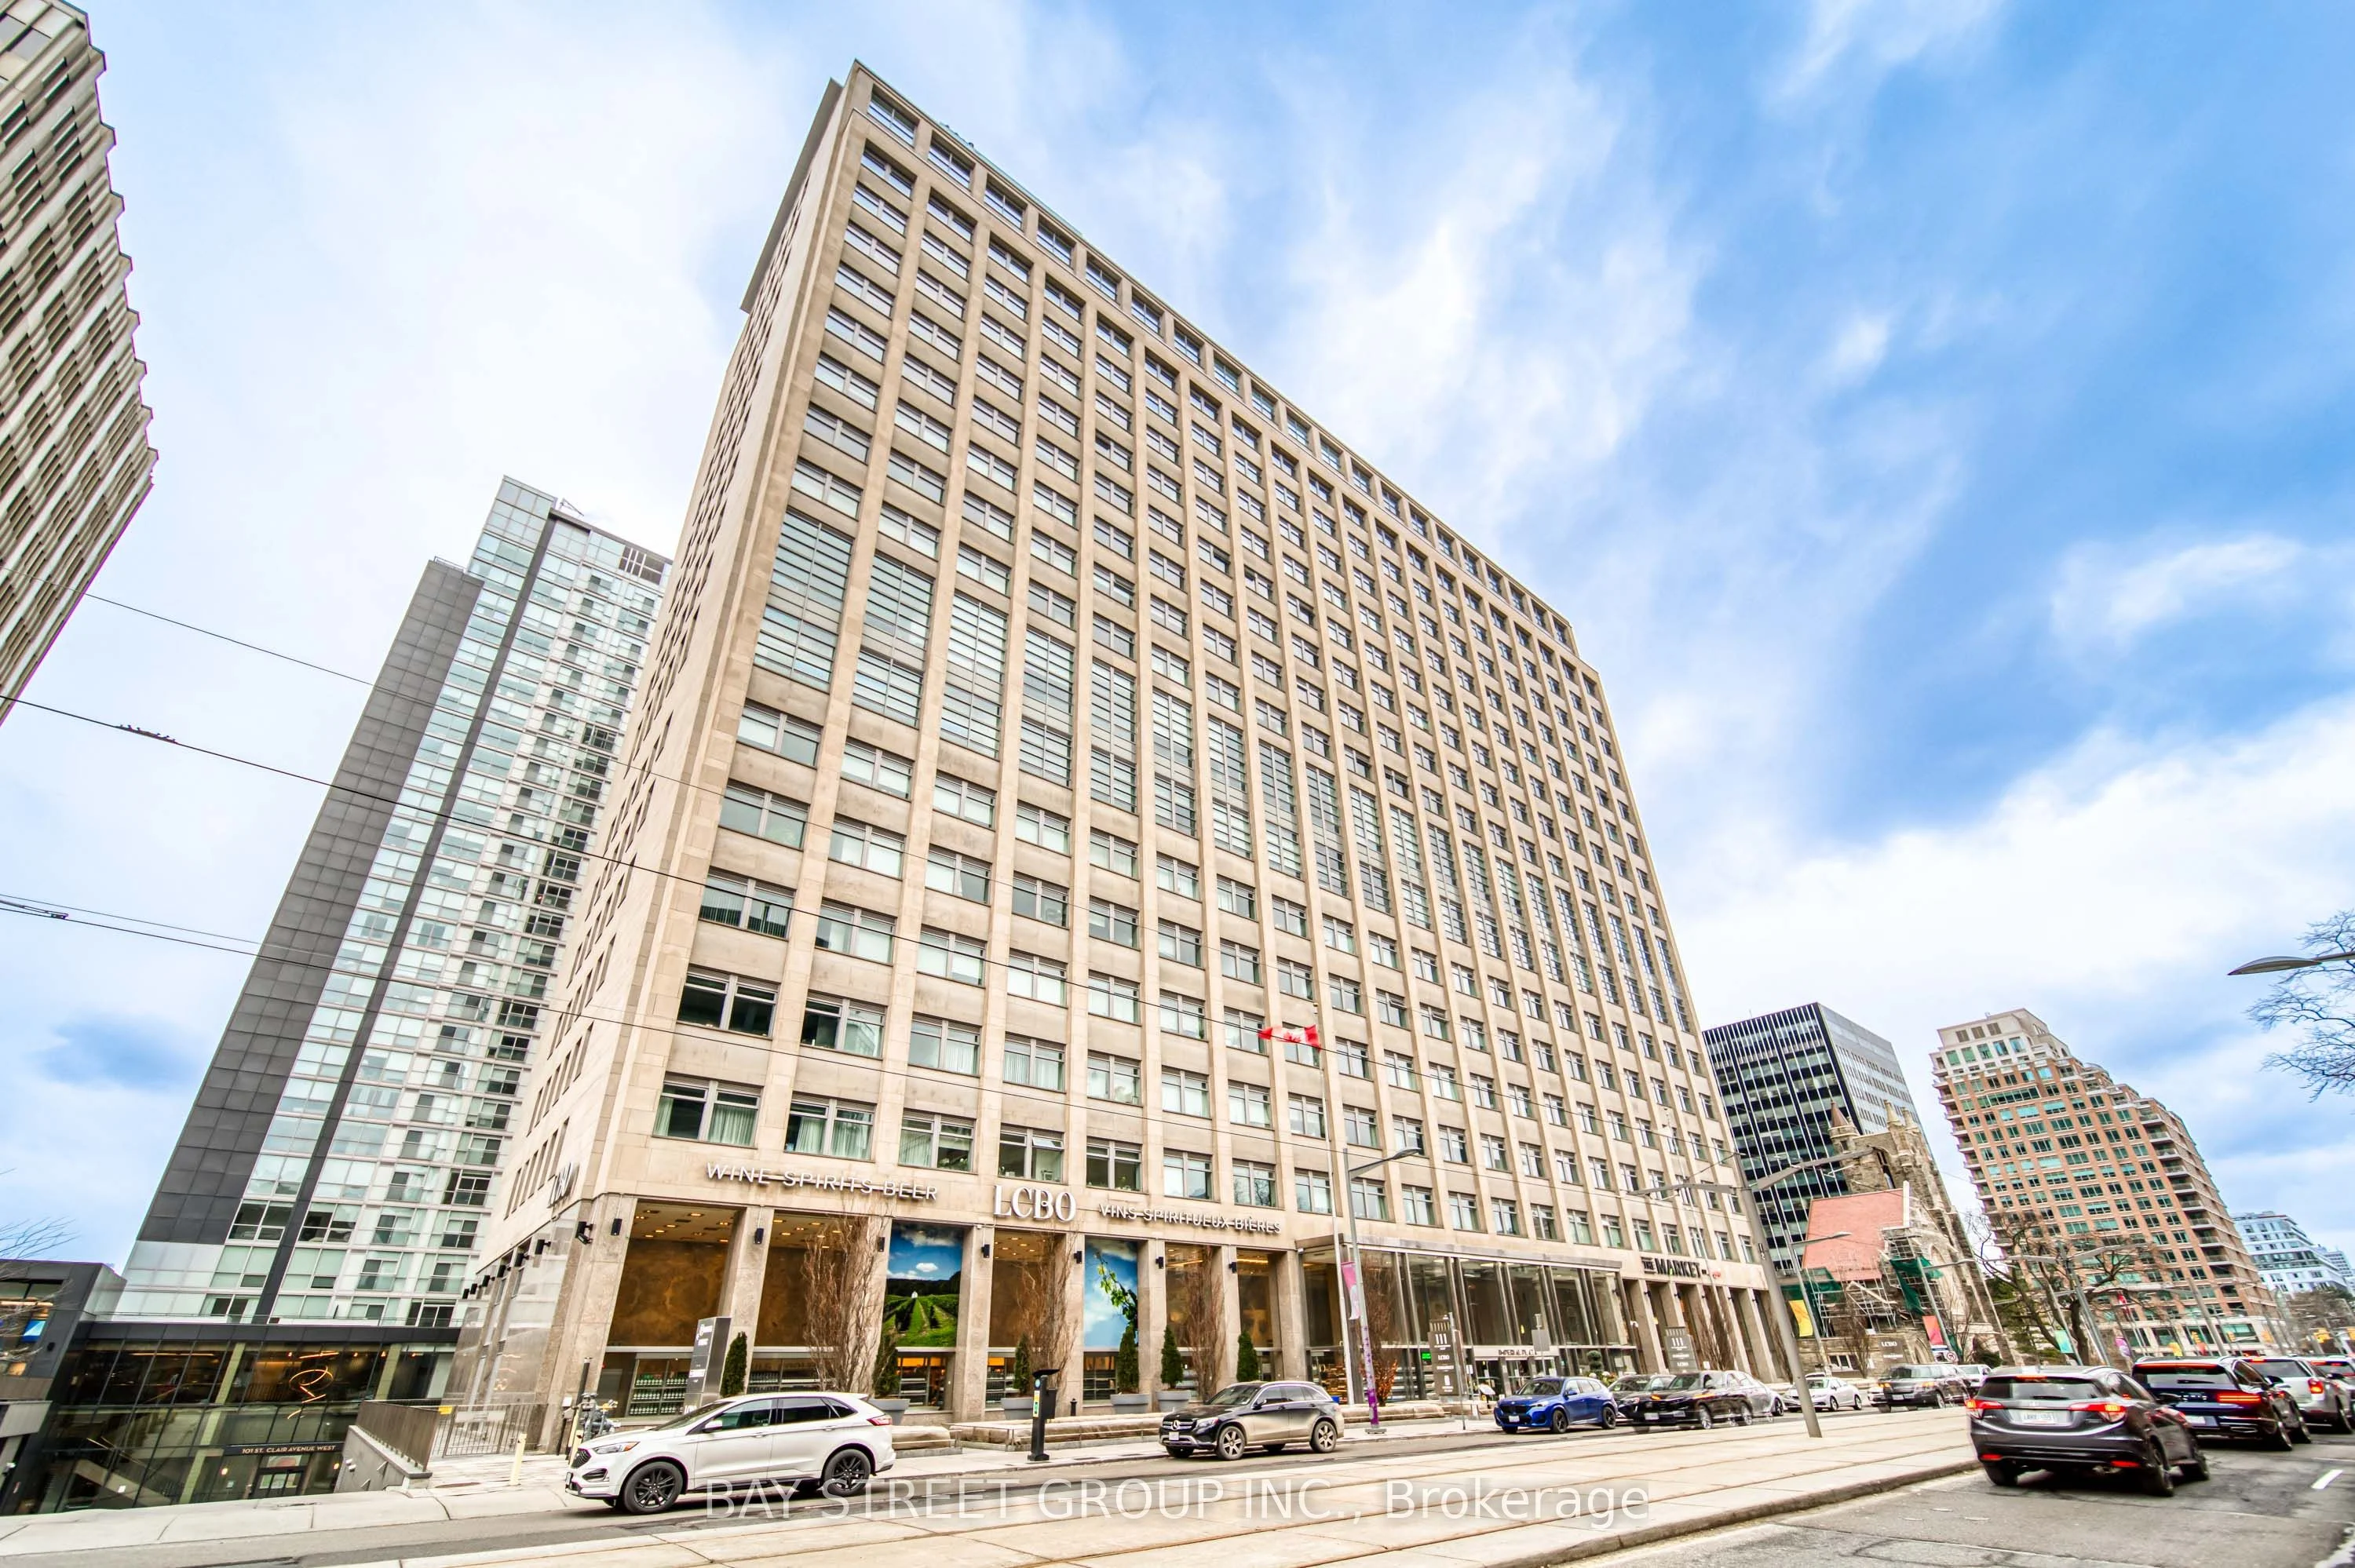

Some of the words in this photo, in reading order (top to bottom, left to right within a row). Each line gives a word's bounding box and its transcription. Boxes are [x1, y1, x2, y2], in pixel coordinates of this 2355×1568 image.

[706, 1161, 771, 1185] WINE
[783, 1170, 874, 1194] SPIRITS
[883, 1180, 938, 1201] BEER
[994, 1184, 1076, 1223] LCBO
[1099, 1204, 1137, 1220] VINS
[1143, 1209, 1230, 1230] SPIRITUEUX
[1234, 1216, 1282, 1234] BIÈRES
[1654, 1258, 1701, 1278] MARKET
[1435, 1334, 1448, 1344] 111
[1671, 1337, 1684, 1347] 111
